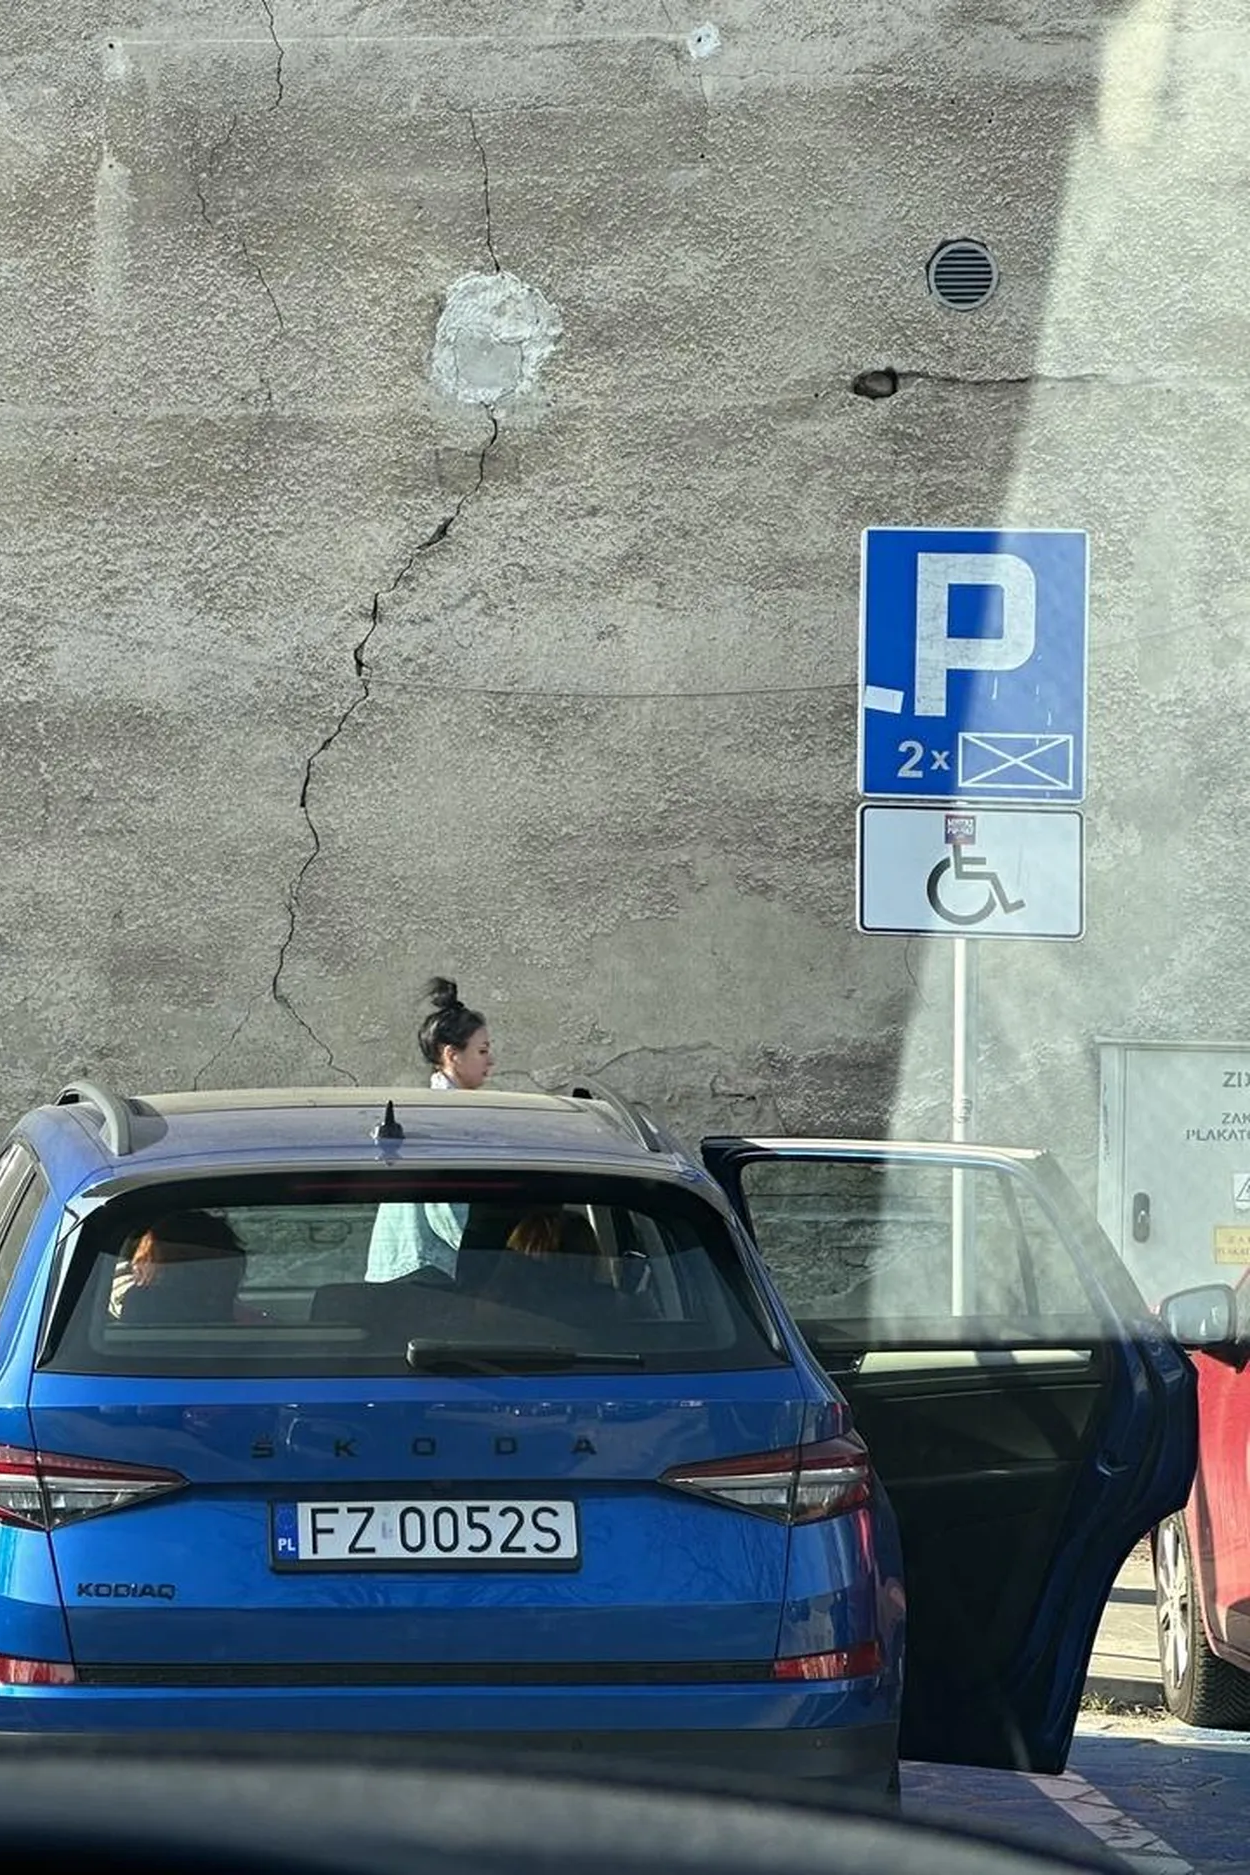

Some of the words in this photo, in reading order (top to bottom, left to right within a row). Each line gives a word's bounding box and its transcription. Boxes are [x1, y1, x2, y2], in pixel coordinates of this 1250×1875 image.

[914, 552, 1036, 717] P
[278, 1538, 296, 1551] PL
[310, 1507, 376, 1555] FZ
[399, 1506, 561, 1553] 0052S
[77, 1583, 176, 1600] KODIAQ
